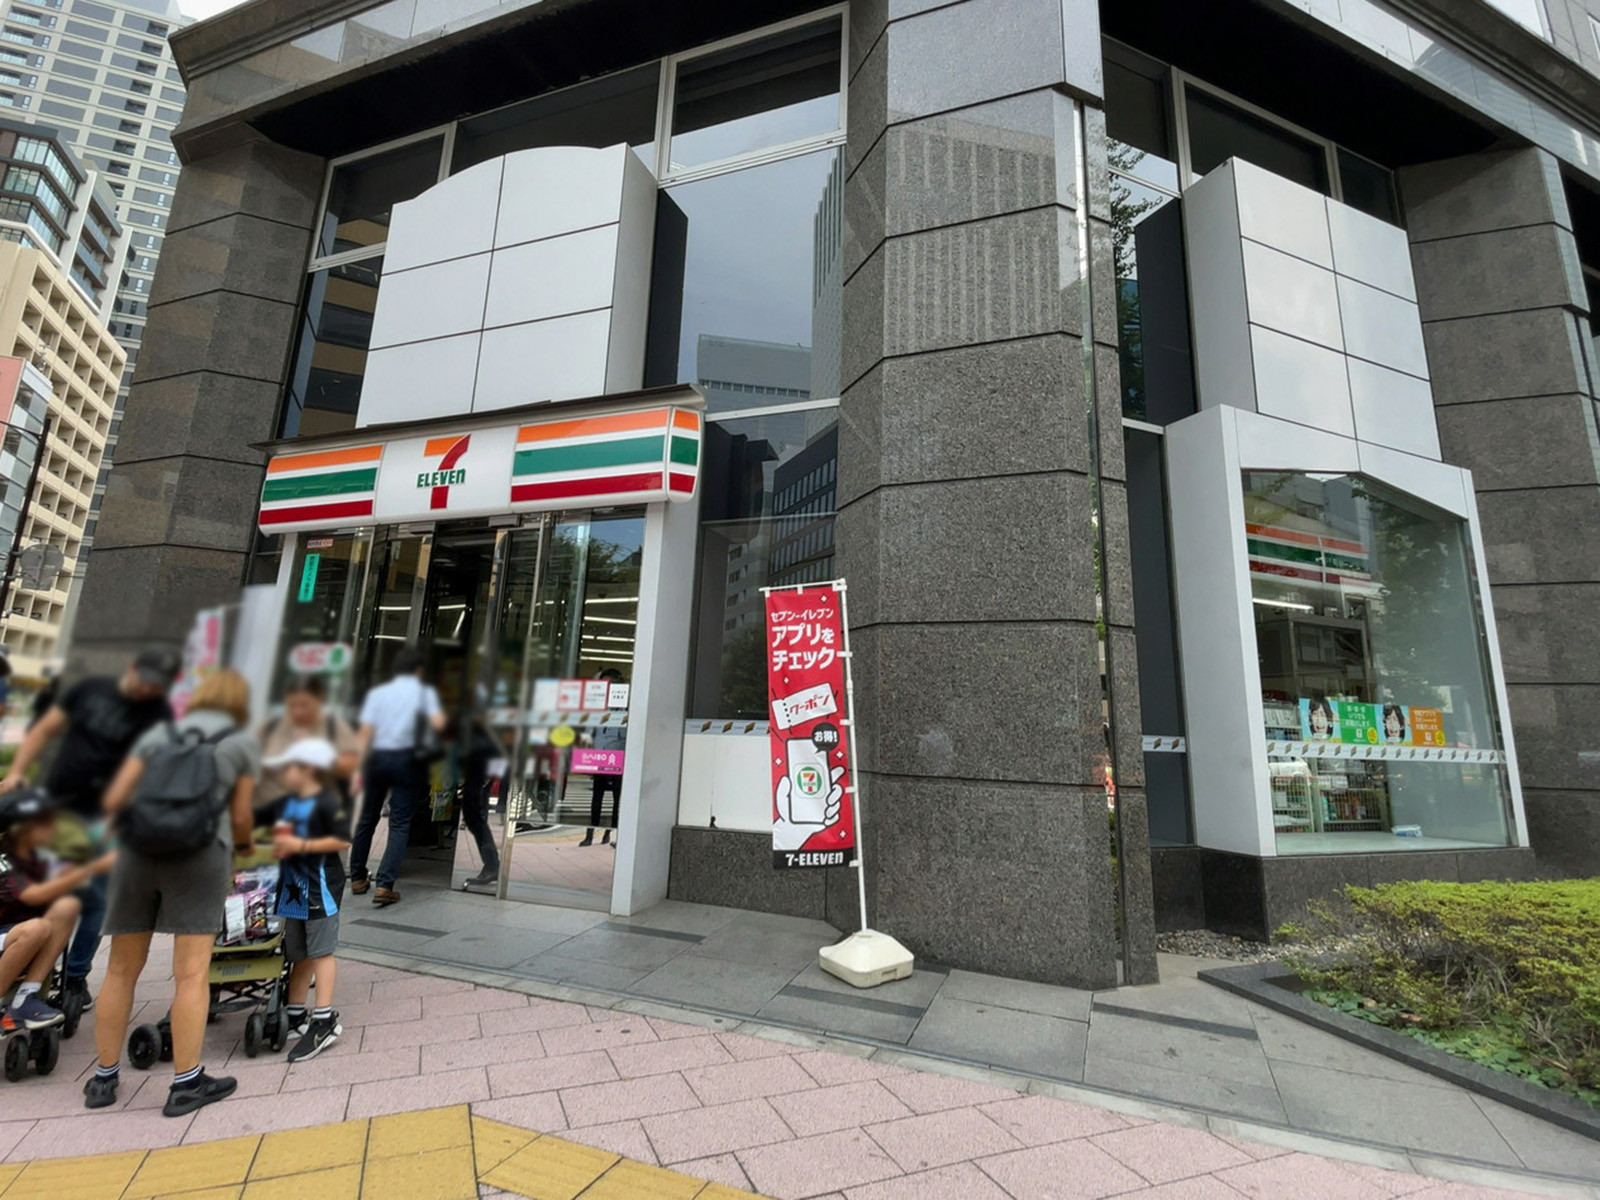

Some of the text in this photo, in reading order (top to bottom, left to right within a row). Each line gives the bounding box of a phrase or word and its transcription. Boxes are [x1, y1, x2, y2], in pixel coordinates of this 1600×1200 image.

[423, 433, 471, 510] 7
[771, 622, 835, 648] アプリを
[772, 646, 835, 672] チェック
